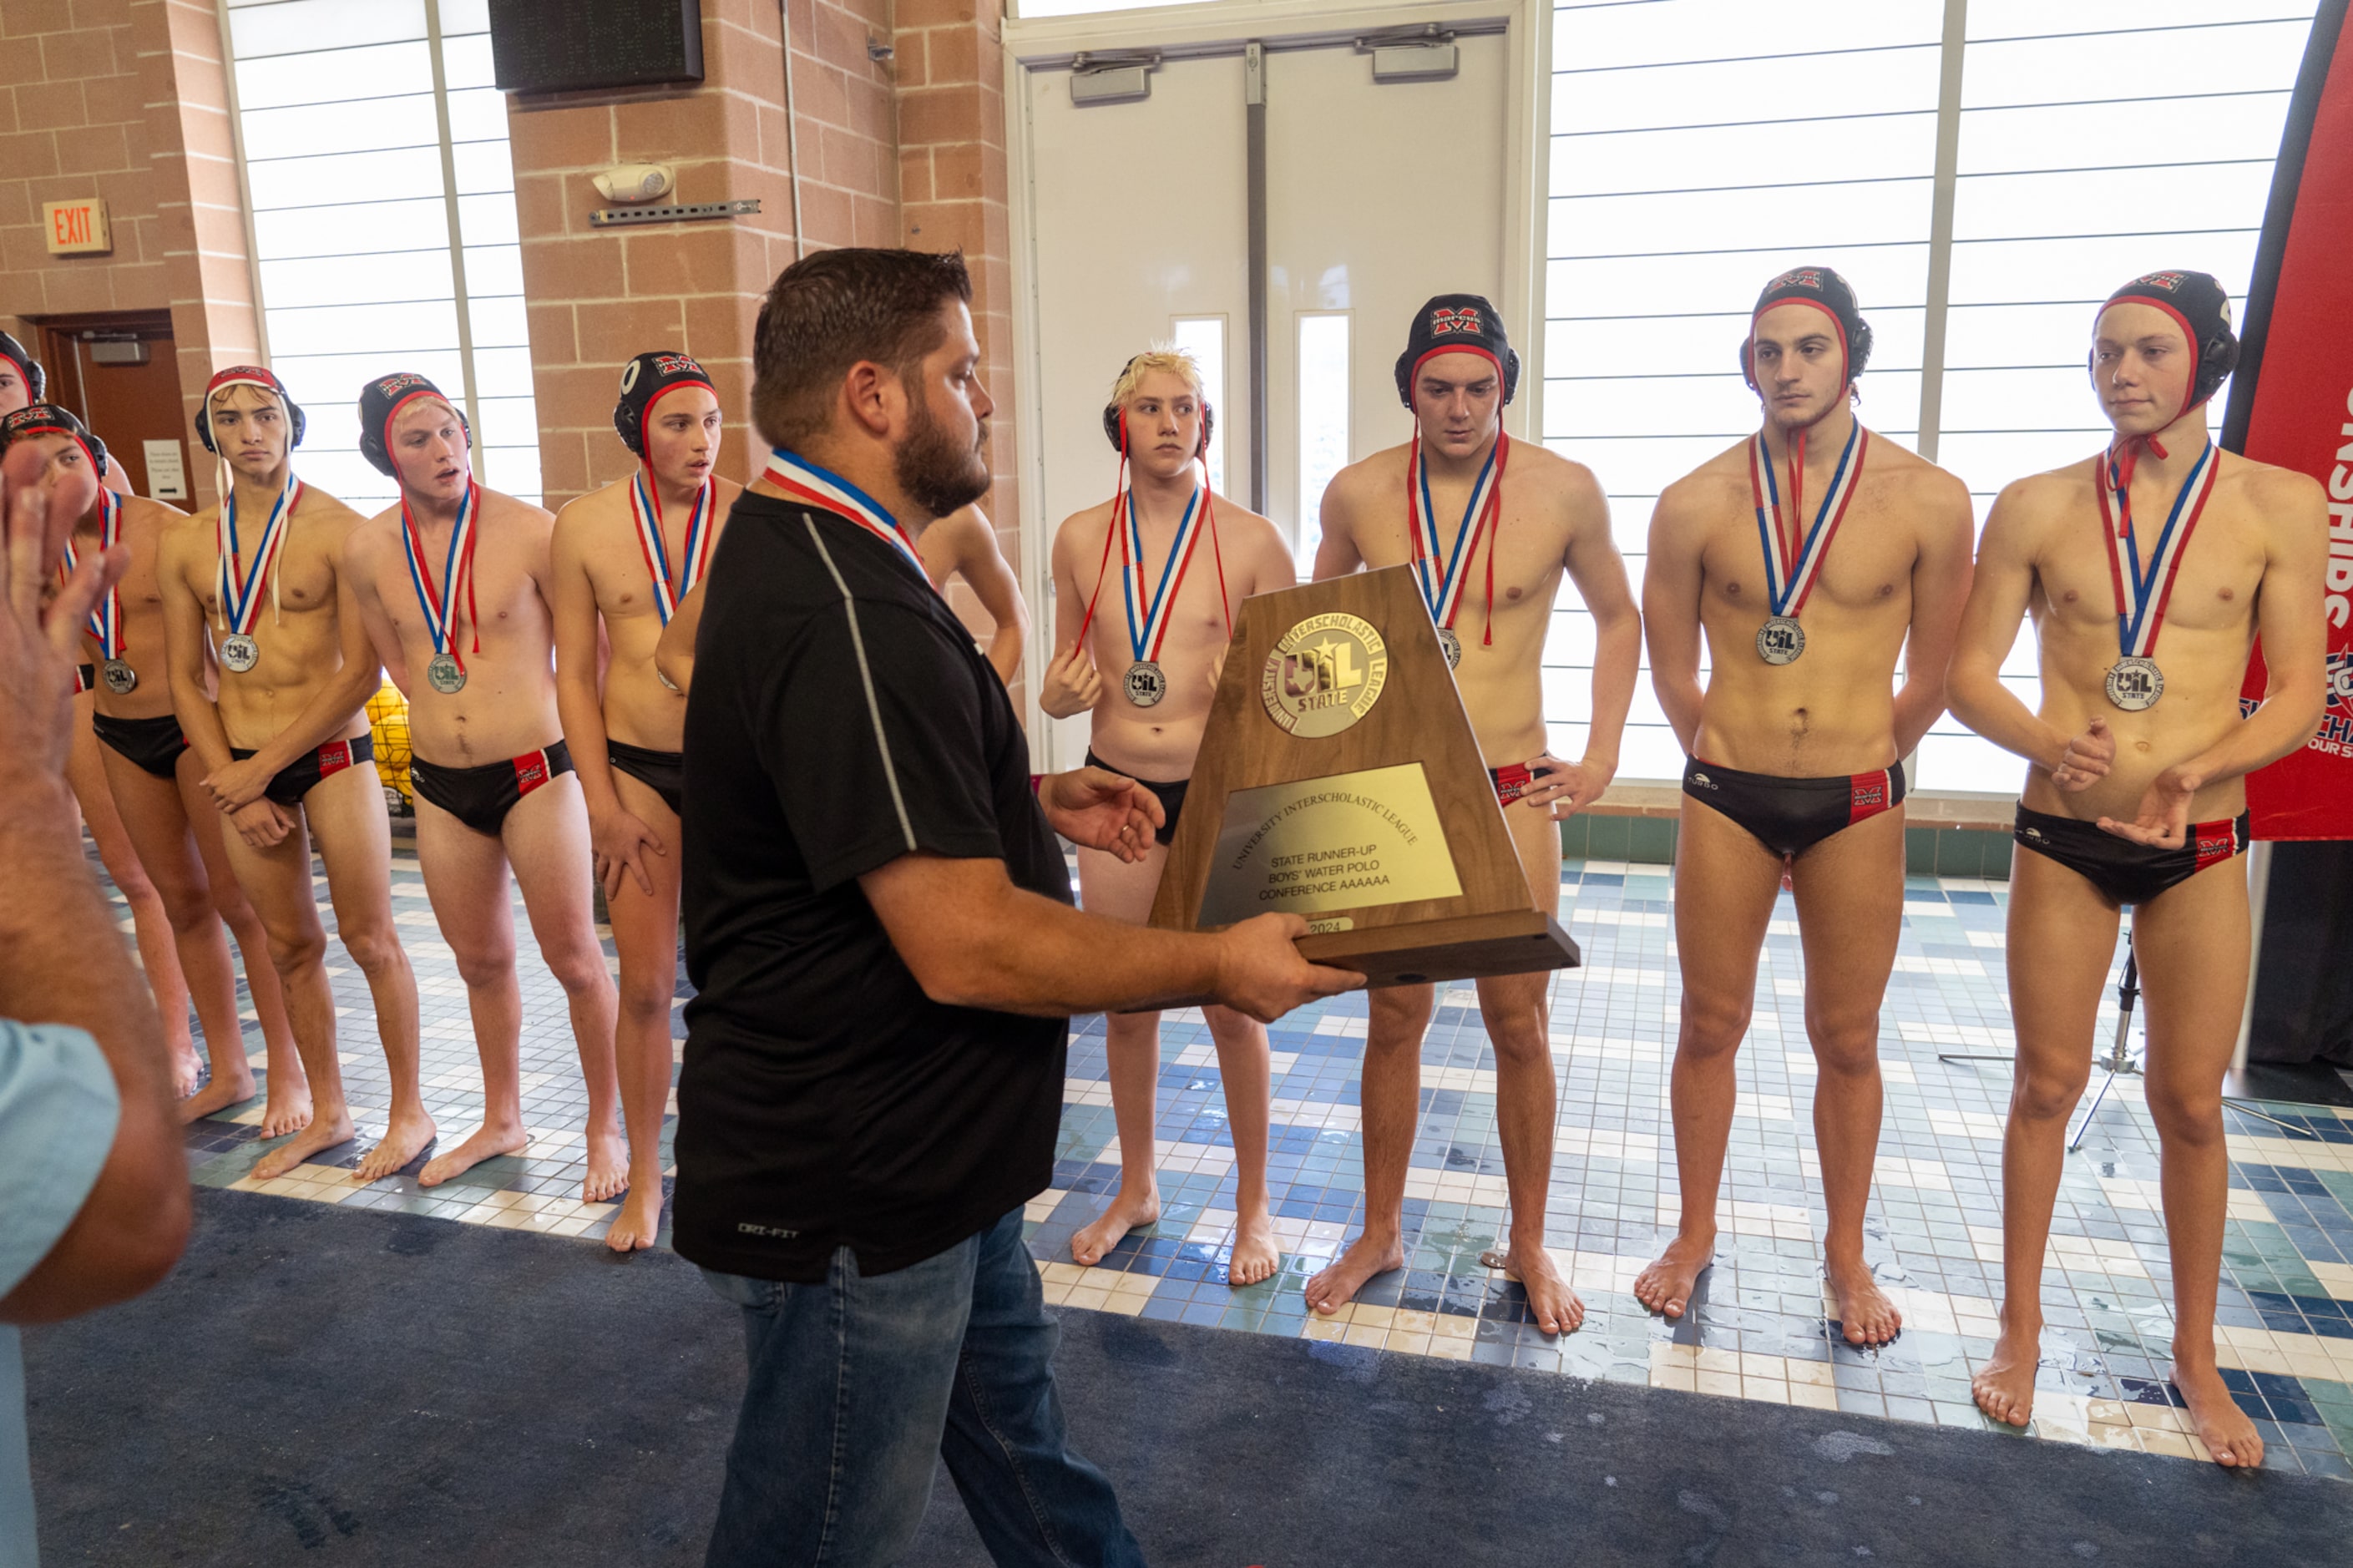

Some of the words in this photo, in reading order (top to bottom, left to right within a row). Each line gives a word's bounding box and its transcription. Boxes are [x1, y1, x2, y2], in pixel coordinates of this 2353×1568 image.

[53, 206, 91, 245] EXIT
[1279, 615, 1382, 652] INTERSCHOLASTIC
[1354, 660, 1384, 715] LEAGUE
[1298, 690, 1348, 712] STATE
[1232, 811, 1283, 871] UNIVERSITY
[1284, 792, 1385, 817] INTERSCHOLASTIC
[1382, 808, 1419, 847] LEAGUE
[1271, 854, 1304, 868] STATE
[1308, 844, 1377, 863] RUNNER-UP
[1305, 864, 1344, 879] WATER
[1347, 860, 1380, 873] POLO
[1258, 880, 1337, 902] CONFERENCE
[1339, 875, 1390, 891] AAAAAA
[1310, 922, 1341, 934] 2024
[737, 1222, 800, 1239] DRI-FIT
